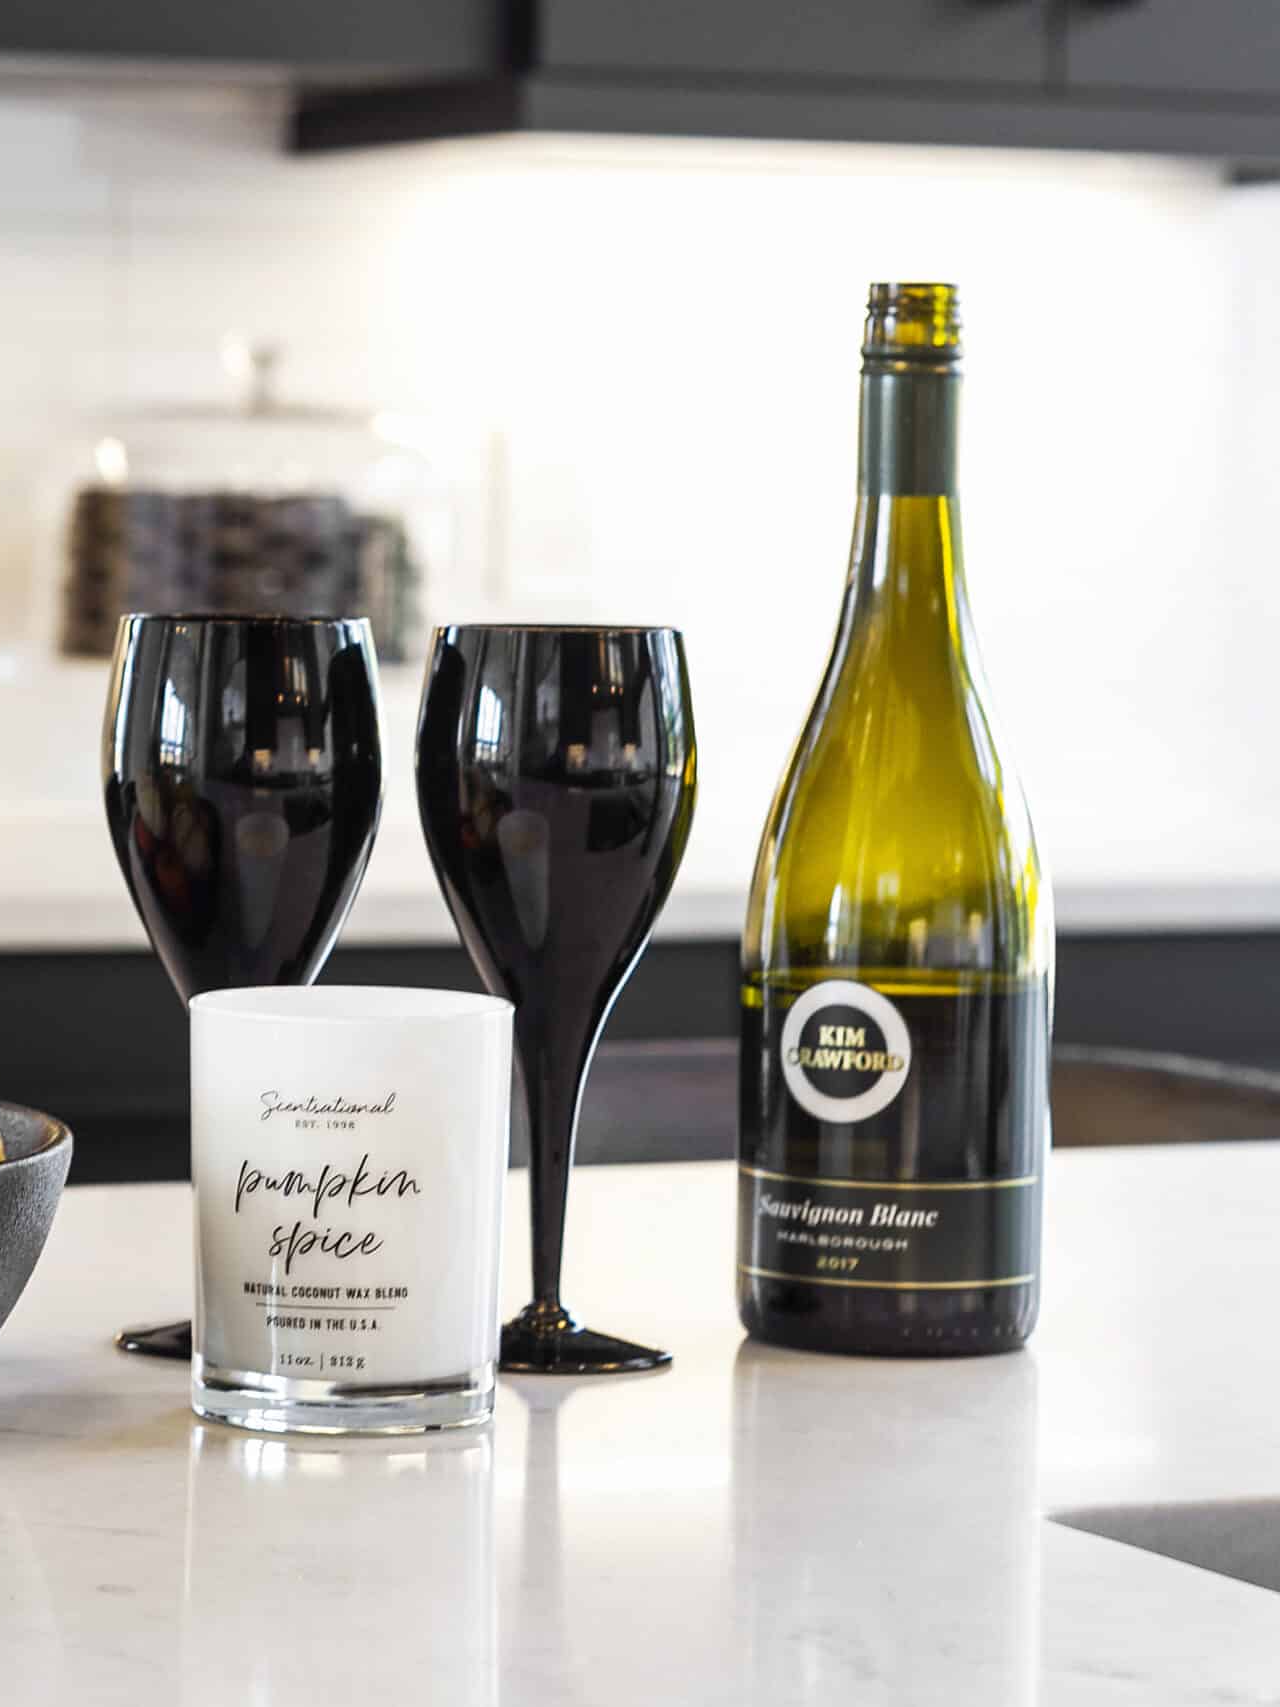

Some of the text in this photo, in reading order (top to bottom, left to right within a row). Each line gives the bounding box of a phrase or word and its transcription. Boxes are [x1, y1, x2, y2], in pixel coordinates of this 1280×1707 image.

[819, 1024, 865, 1047] KIM
[786, 1047, 905, 1071] CRAWFORD
[234, 1153, 421, 1219] pumpkin
[757, 1193, 939, 1228] Sauvignon Blanc
[268, 1221, 384, 1275] spice
[776, 1230, 909, 1251] MARLBOROUGH
[816, 1256, 860, 1271] 2017
[243, 1282, 408, 1300] NATURAL COCONUT WAX BLEND
[266, 1315, 305, 1330] POURED
[309, 1317, 321, 1330] IN
[326, 1318, 345, 1331] THE
